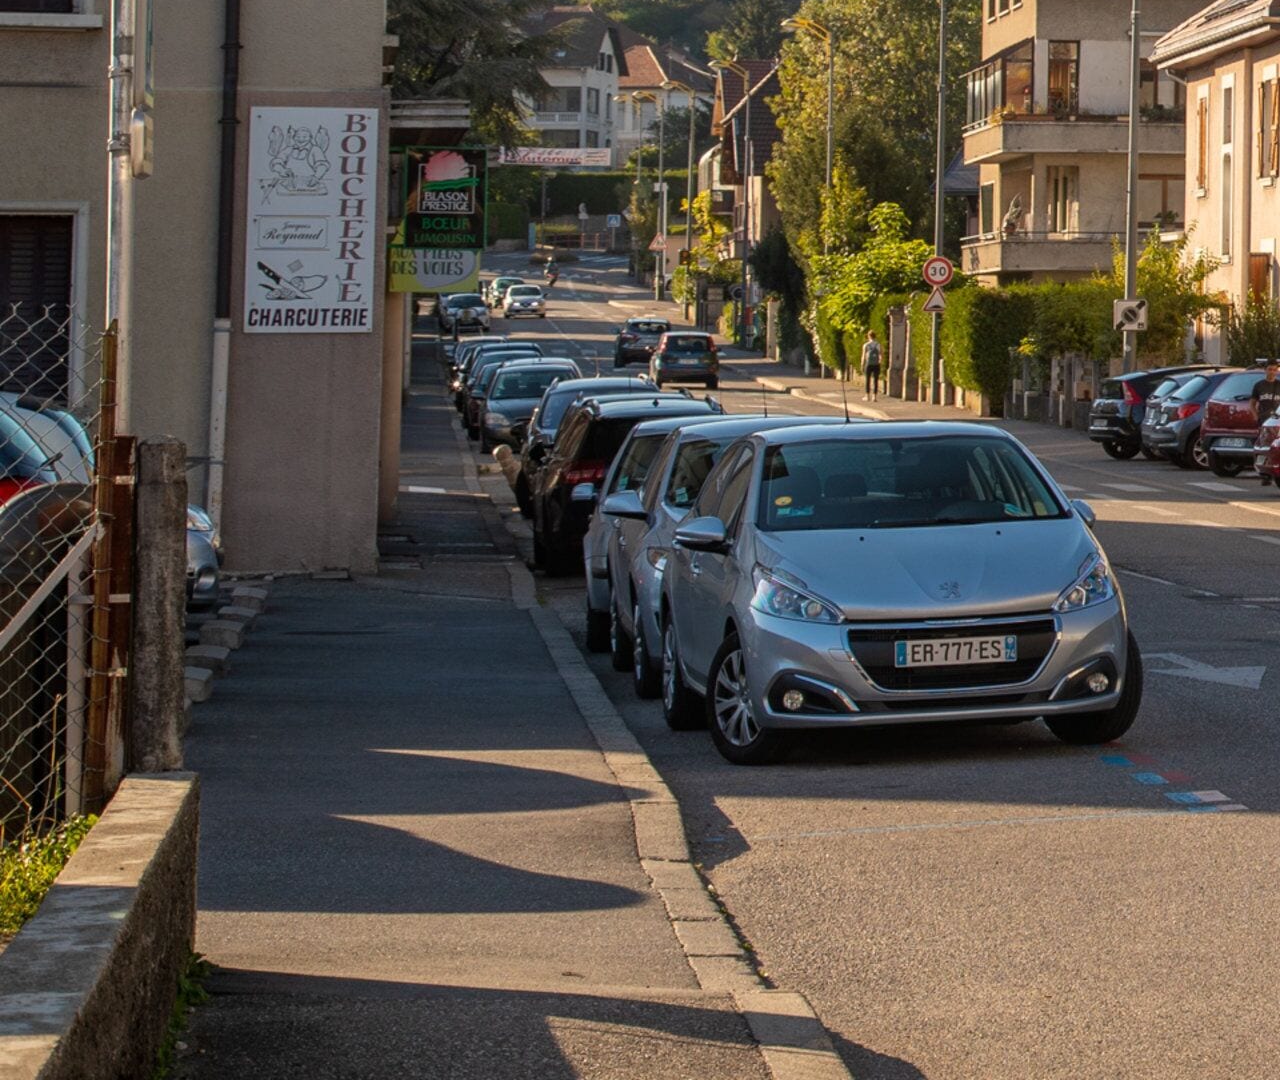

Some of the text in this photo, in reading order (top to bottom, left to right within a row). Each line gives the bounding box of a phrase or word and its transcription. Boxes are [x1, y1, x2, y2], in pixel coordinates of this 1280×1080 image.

[423, 192, 469, 201] BLASON
[336, 114, 368, 303] BOUCHERIE
[422, 201, 469, 211] PRESTIGE
[422, 217, 471, 230] BŒUF
[262, 228, 324, 245] Reynaud
[414, 233, 476, 243] LIMOUSIN
[423, 249, 463, 260] PIEDS
[392, 261, 464, 276] DES VOIES
[930, 266, 947, 277] 30
[248, 308, 368, 327] CHARCUTERIE
[911, 640, 1001, 663] ER-777-ES
